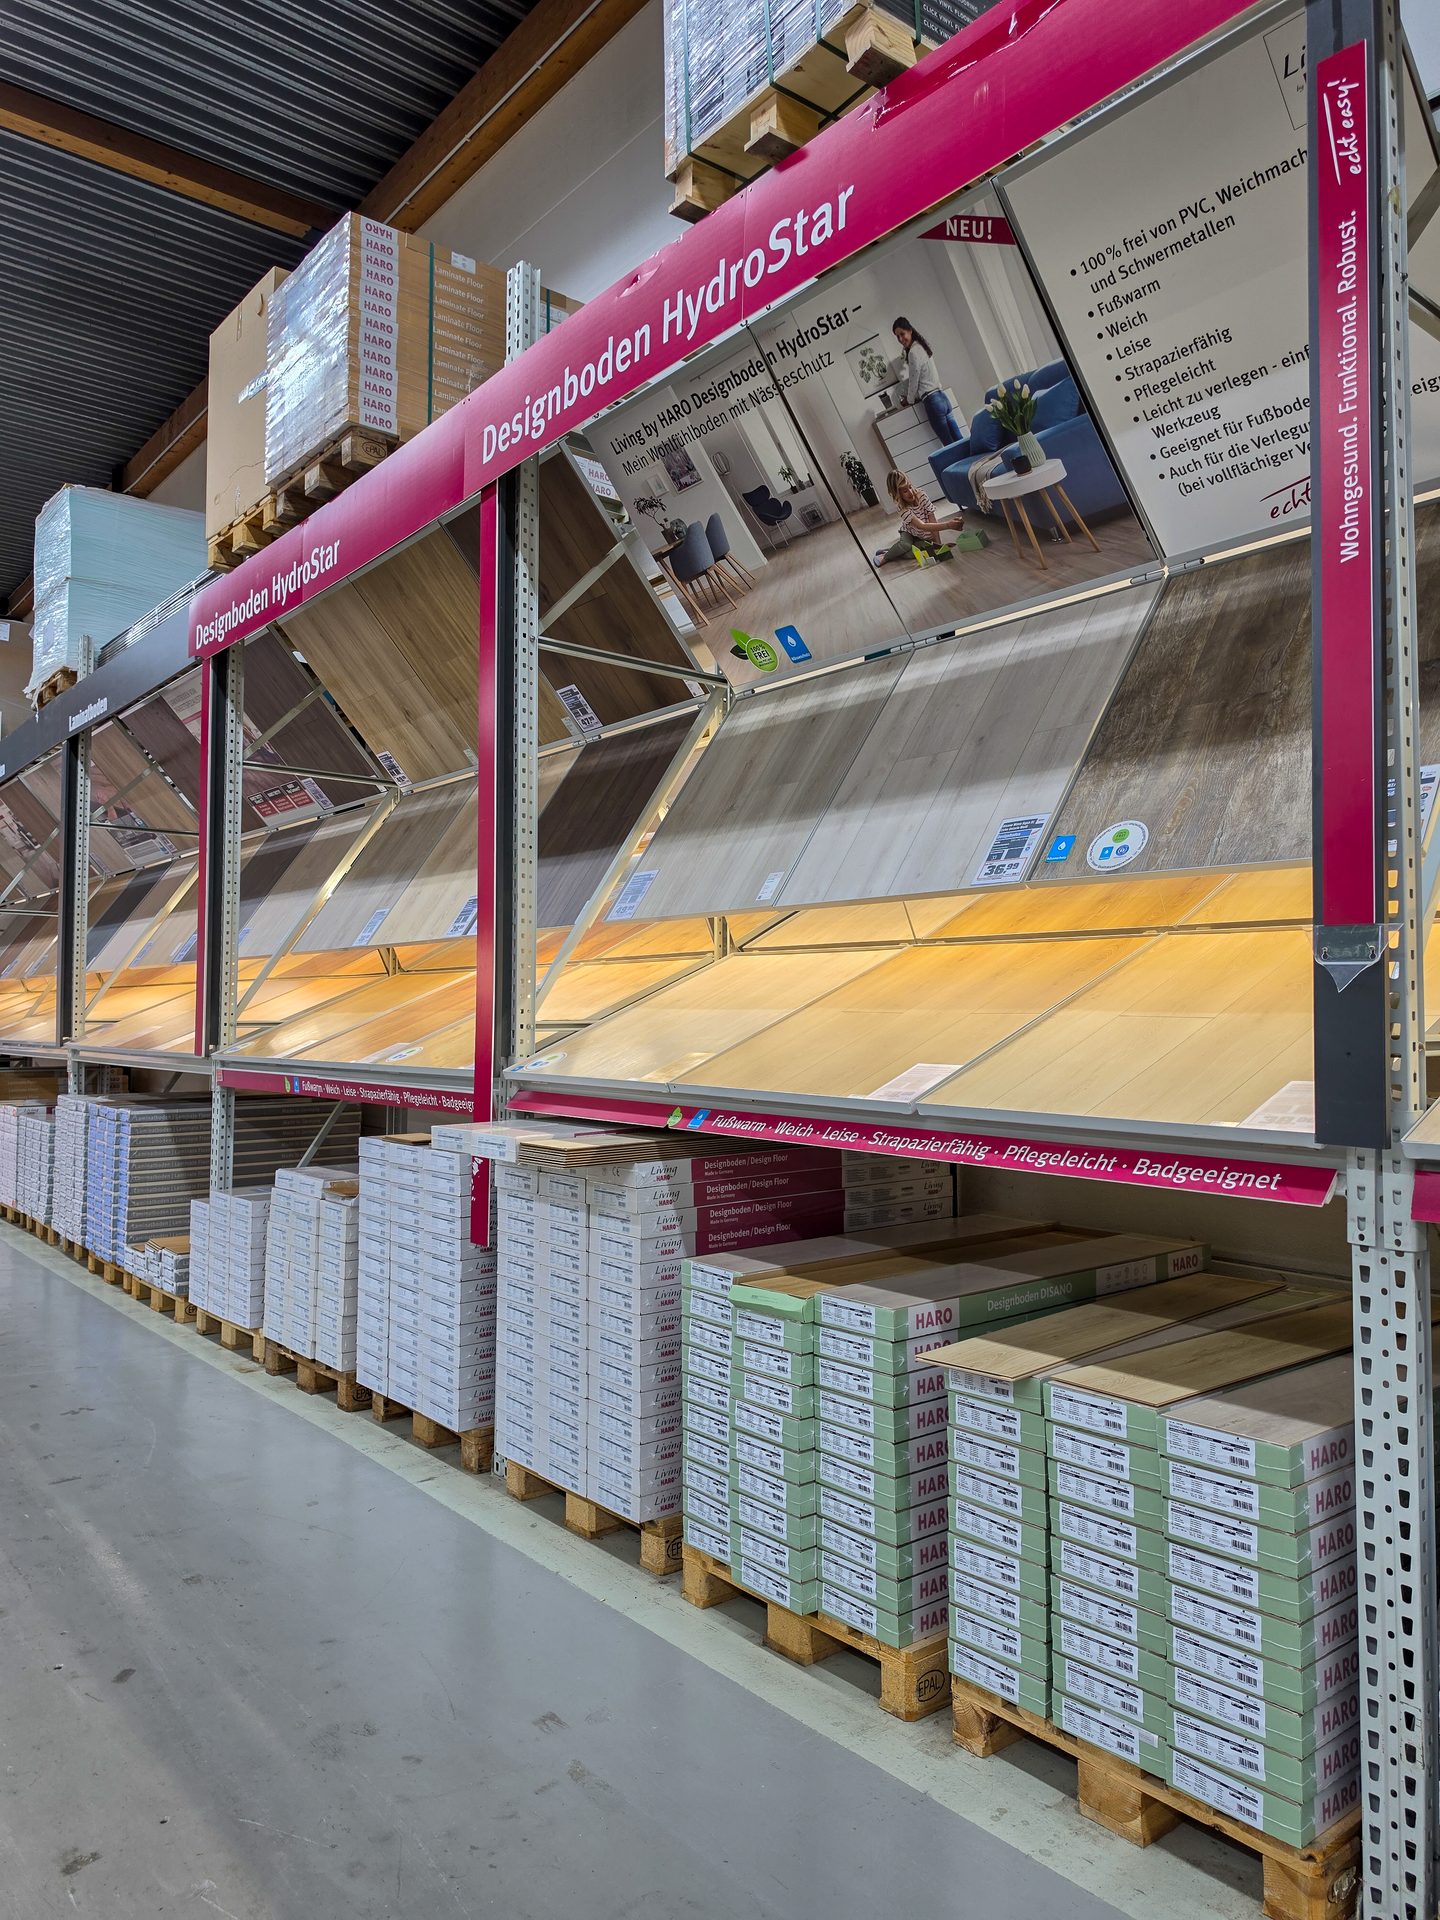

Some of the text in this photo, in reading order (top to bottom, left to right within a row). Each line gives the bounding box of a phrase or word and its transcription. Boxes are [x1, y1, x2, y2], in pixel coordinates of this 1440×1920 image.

[922, 4, 938, 18] CLICK
[923, 19, 939, 33] CLICK
[1327, 77, 1362, 174] echt easy!
[365, 222, 392, 240] HARO
[946, 219, 992, 240] NEU!
[1122, 229, 1148, 253] frei
[1149, 217, 1178, 239] von
[1178, 197, 1217, 225] PVC,
[366, 238, 394, 256] HARO
[1090, 214, 1236, 294] und Schwermetallen
[366, 254, 393, 271] HARO
[366, 269, 394, 286] HARO
[364, 285, 392, 302] HARO
[1096, 278, 1161, 317] Fußwarm
[364, 300, 392, 317] HARO
[366, 317, 393, 334] HARO
[482, 184, 854, 464] Designboden HydroStar
[1105, 310, 1149, 339] Weich
[364, 333, 392, 350] HARO
[1115, 336, 1152, 360] Leise
[364, 349, 391, 366] HARO
[1125, 327, 1233, 381] Strapazierfähig
[365, 365, 393, 382] HARO
[610, 310, 850, 456] Living by HARO Designboden HydroStar
[1134, 358, 1217, 402] Pflegeleicht
[364, 381, 392, 397] HARO
[1142, 396, 1183, 422] Leicht
[1186, 388, 1204, 406] zu
[1204, 364, 1270, 398] verlegen
[1337, 209, 1363, 564] Wohngesund. Funktional. Robust.
[364, 397, 391, 413] HARO
[622, 351, 835, 477] Mein Wohlfühlboden mit Nässeschutz
[364, 413, 392, 430] HARO
[1151, 405, 1222, 439] Werkzeug
[1160, 427, 1223, 460] Geeignet
[1223, 419, 1244, 438] für
[1169, 456, 1202, 480] Auch
[1204, 449, 1225, 469] für
[1228, 441, 1250, 460] die
[1250, 420, 1311, 450] Verlegu
[1178, 478, 1205, 497] (bei
[1207, 448, 1295, 486] vollflächiger
[196, 540, 340, 650] Designboden HydroStar
[302, 1080, 323, 1096] Fußwarm
[325, 1084, 341, 1095] Weich
[344, 1086, 357, 1098] Leise
[359, 1087, 400, 1104] Strapazierfähig
[403, 1091, 438, 1108] Pflegeleicht
[711, 1114, 1282, 1191] Fußwarm Weich Leise Strapazierfähig Pflegeleicht Badgeeignet
[773, 1154, 788, 1162] Floor
[650, 1164, 678, 1177] Living
[774, 1177, 790, 1185] Floor
[653, 1189, 680, 1202] Living
[778, 1200, 792, 1208] Floor
[656, 1214, 684, 1227] Living
[776, 1223, 792, 1232] Floor
[655, 1238, 682, 1252] Living
[655, 1264, 682, 1276] Living
[1172, 1254, 1198, 1273] HARO
[655, 1288, 682, 1301] Living
[987, 1282, 1073, 1312] Designboden DISANO
[655, 1313, 682, 1326] Living
[916, 1307, 952, 1330] HARO
[656, 1339, 682, 1352] Living
[655, 1364, 682, 1378] Living
[656, 1389, 682, 1402] Living
[917, 1374, 944, 1396] HAR
[655, 1414, 682, 1428] Living
[654, 1440, 682, 1454] Living
[1311, 1438, 1348, 1470] HARO
[654, 1467, 682, 1480] Living
[654, 1492, 682, 1506] Living
[1316, 1480, 1351, 1514] HARO
[918, 1507, 948, 1532] HAR
[1318, 1523, 1354, 1559] HARO
[920, 1541, 947, 1566] HAR
[920, 1575, 946, 1600] HAR
[1320, 1565, 1356, 1602] HARO
[920, 1608, 947, 1634] HAR
[1322, 1607, 1357, 1648] HARO
[1324, 1651, 1358, 1692] HARO
[918, 1677, 940, 1698] EPAL
[1322, 1694, 1358, 1737] HARO
[1322, 1737, 1358, 1780] HARO
[1322, 1780, 1357, 1824] HARO
